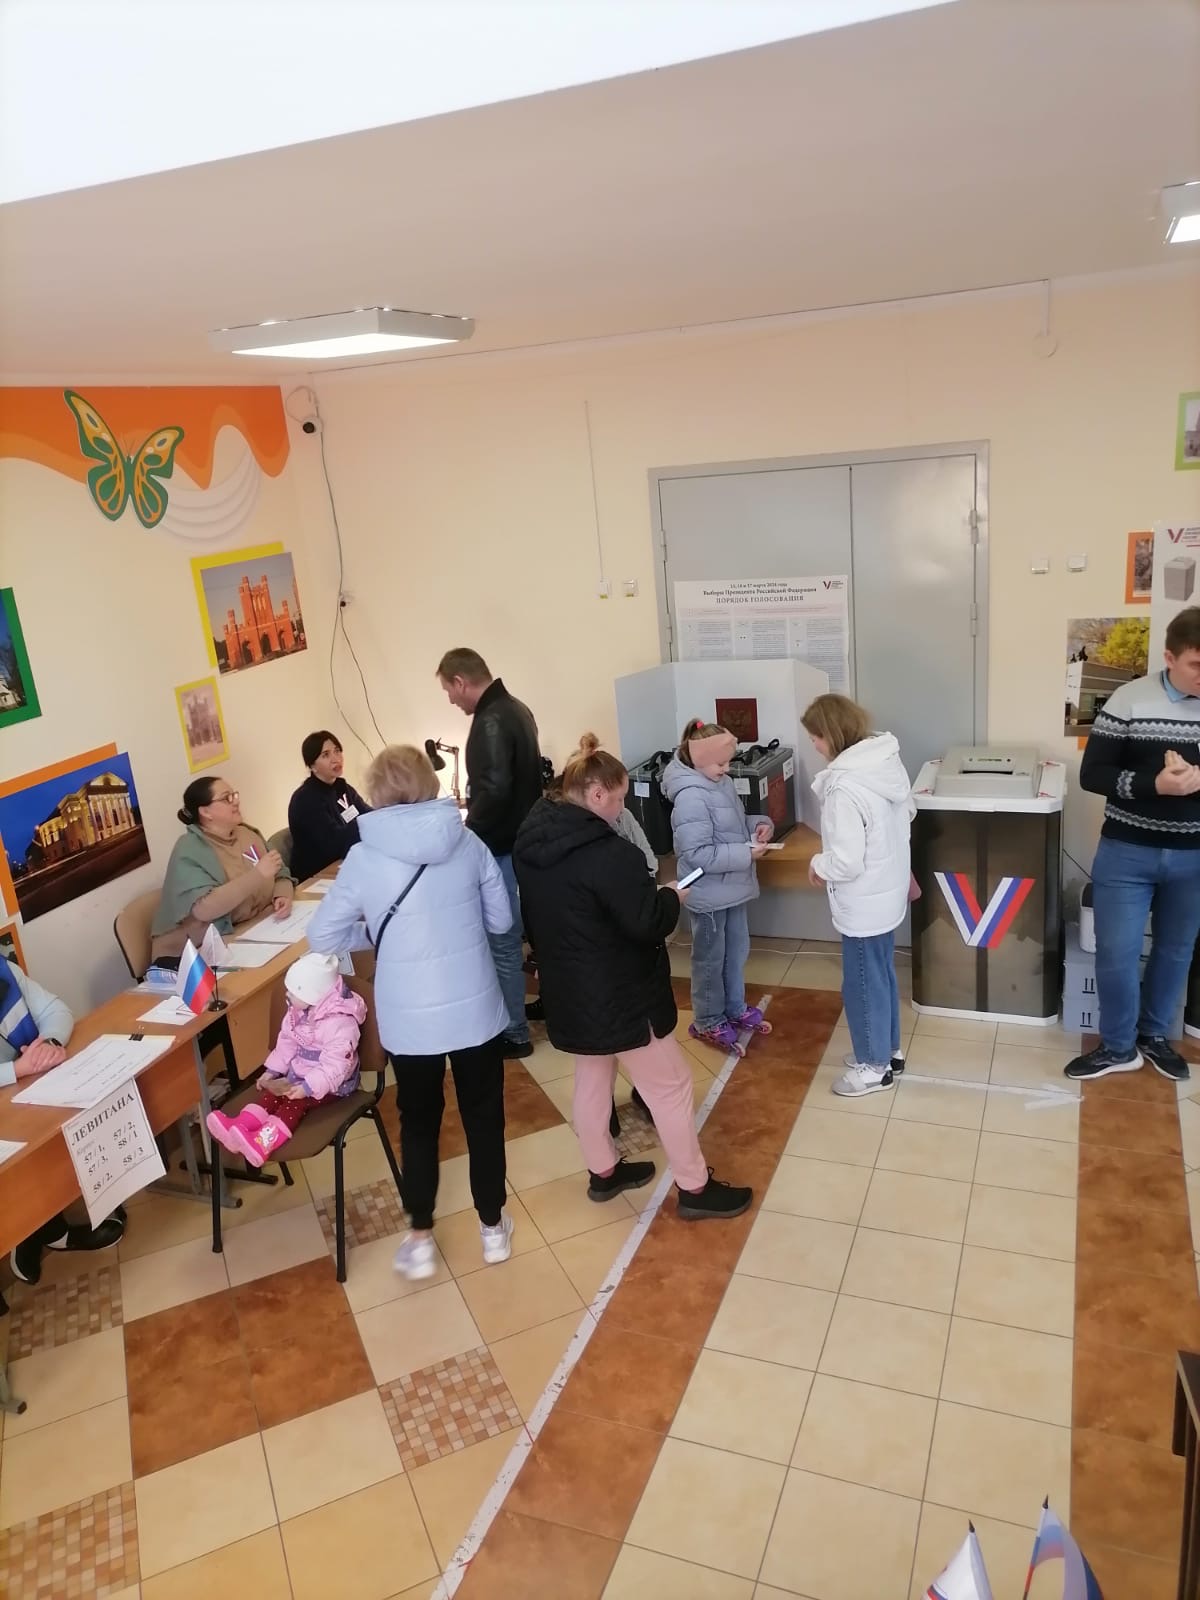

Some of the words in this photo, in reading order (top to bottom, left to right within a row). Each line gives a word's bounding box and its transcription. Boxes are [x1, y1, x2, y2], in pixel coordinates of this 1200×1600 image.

[716, 596, 748, 604] ПОРЯДОК
[750, 595, 804, 603] ГОЛОСОВАНИЯ
[71, 1092, 135, 1146] ЛЕВИТАНА
